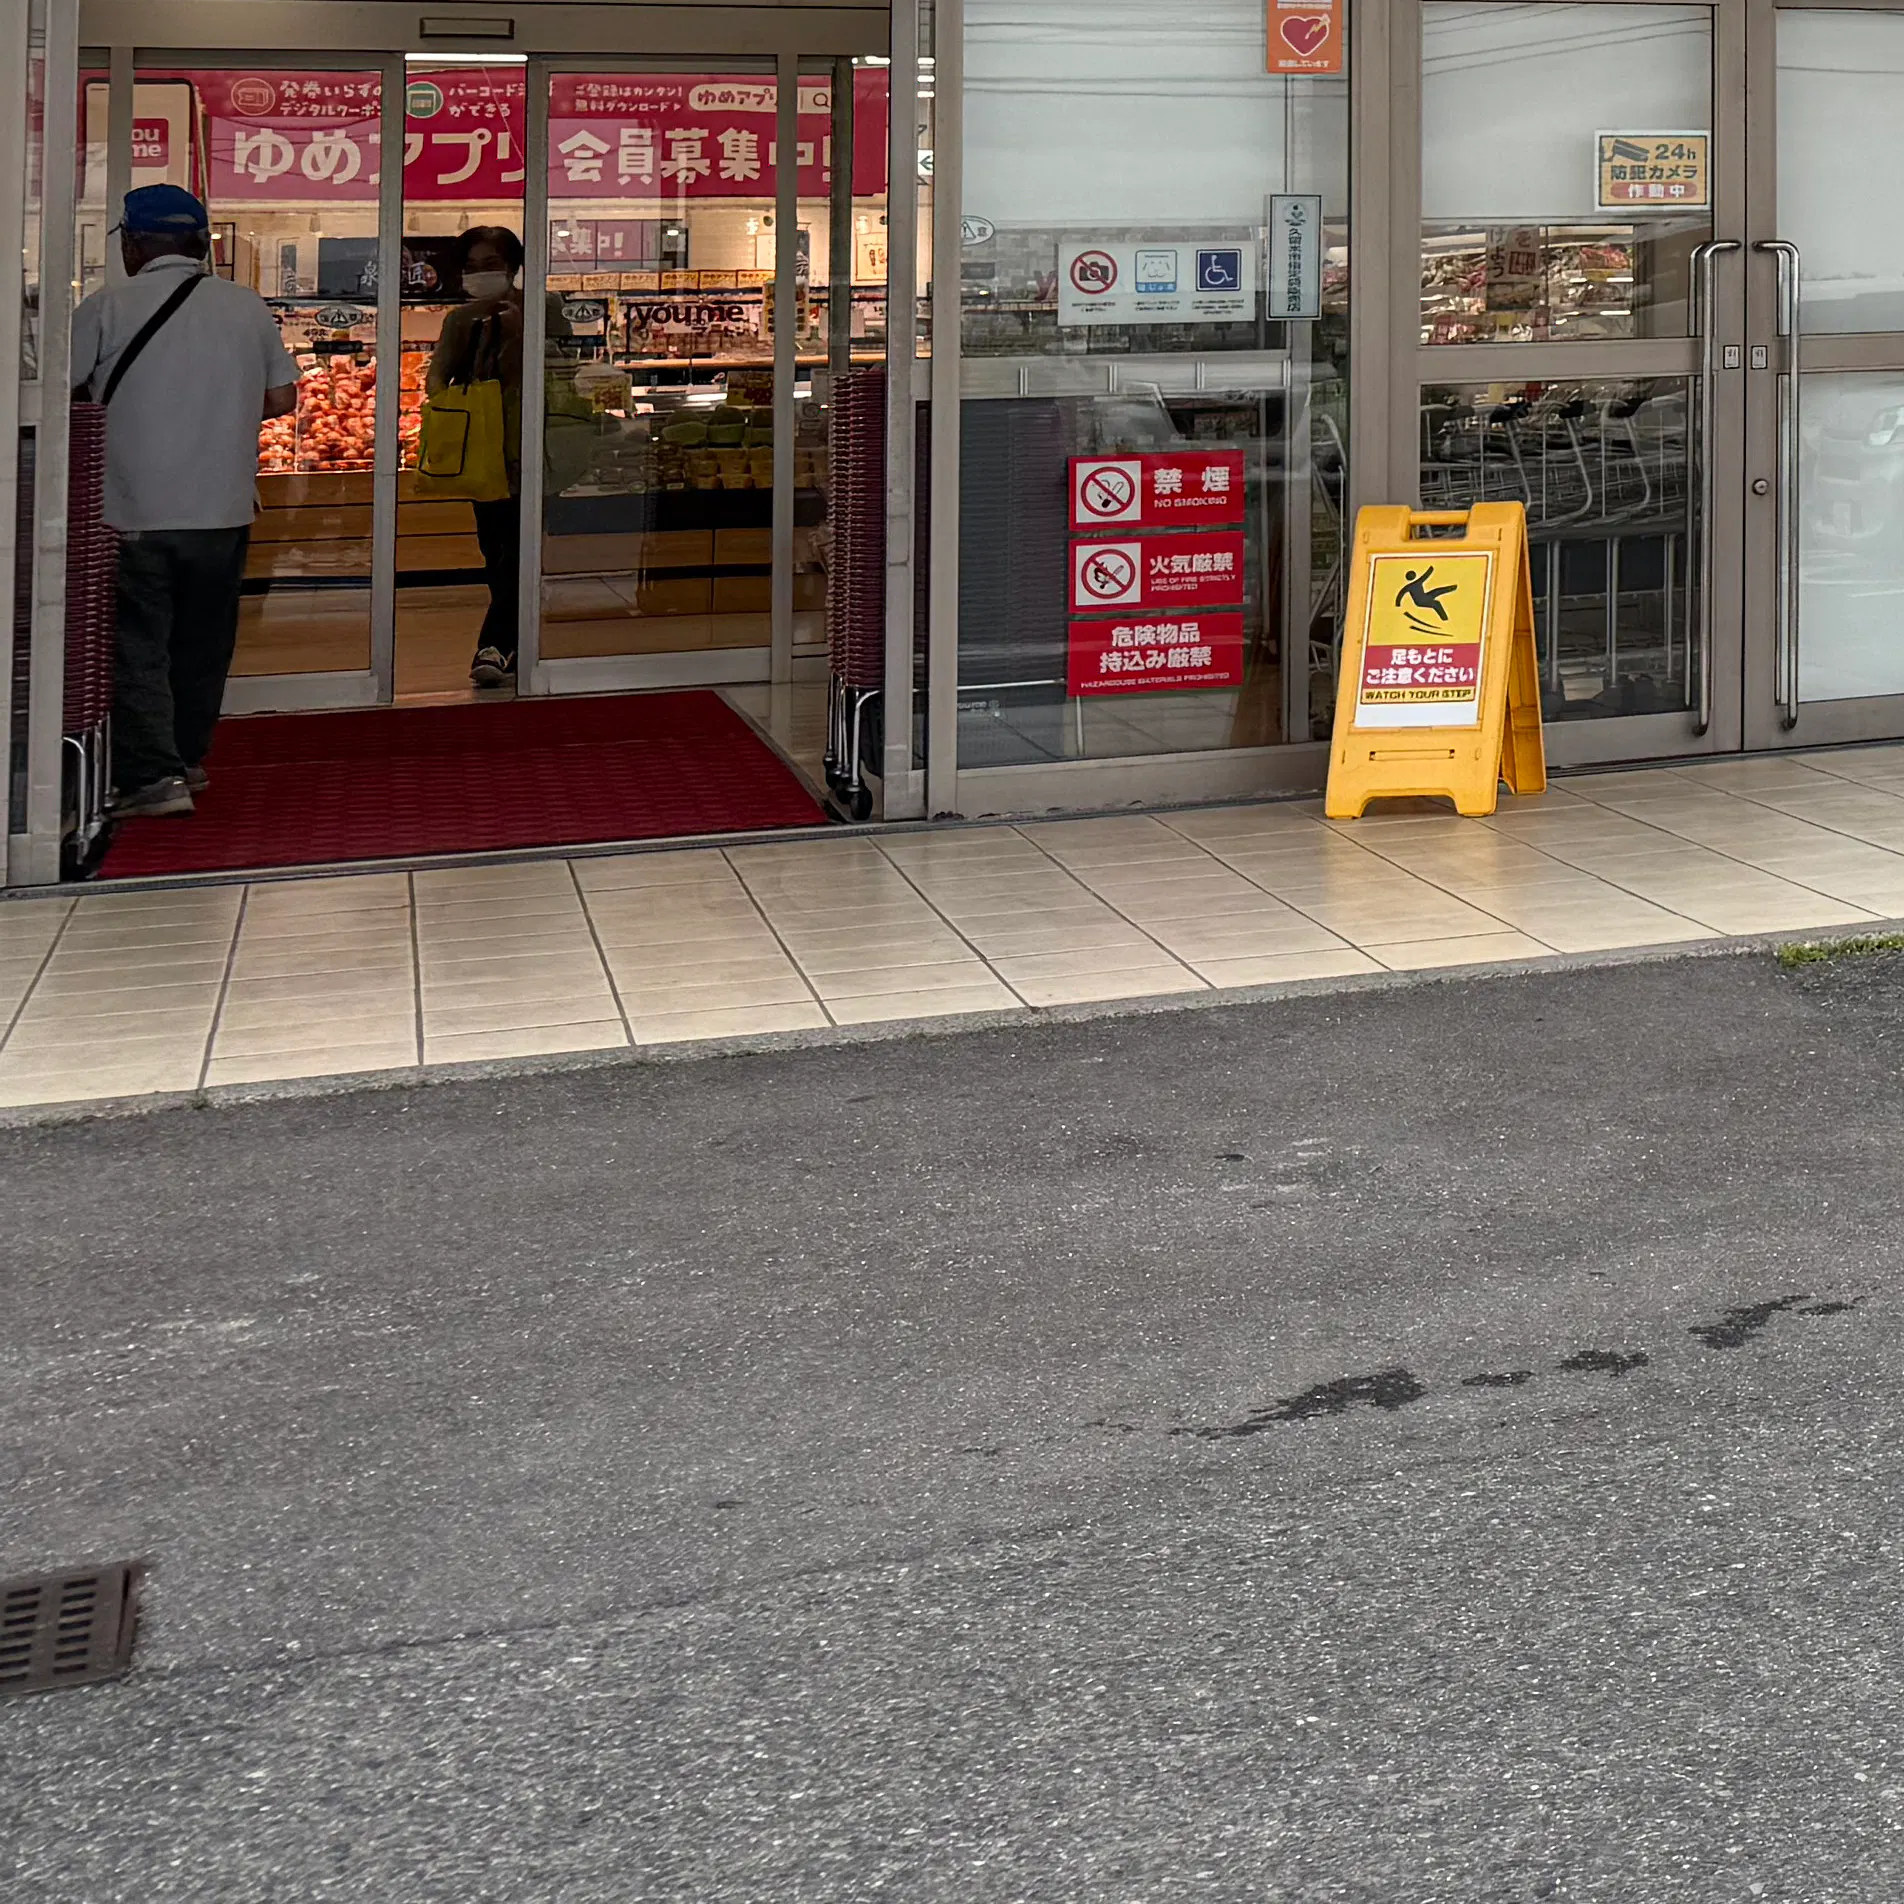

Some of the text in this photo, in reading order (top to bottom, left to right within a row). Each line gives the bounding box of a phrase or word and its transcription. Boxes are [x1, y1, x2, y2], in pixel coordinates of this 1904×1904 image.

[1654, 143, 1697, 161] 24h
[1153, 496, 1228, 508] NO SMOKING
[1149, 552, 1234, 575] 火気厳禁
[1111, 622, 1201, 647] 危険物品
[1100, 646, 1212, 673] 持込み厳禁
[1390, 648, 1454, 665] 足もとに
[1366, 667, 1474, 685] ご注意ください
[1365, 689, 1472, 700] WATCH YOUR STEP
